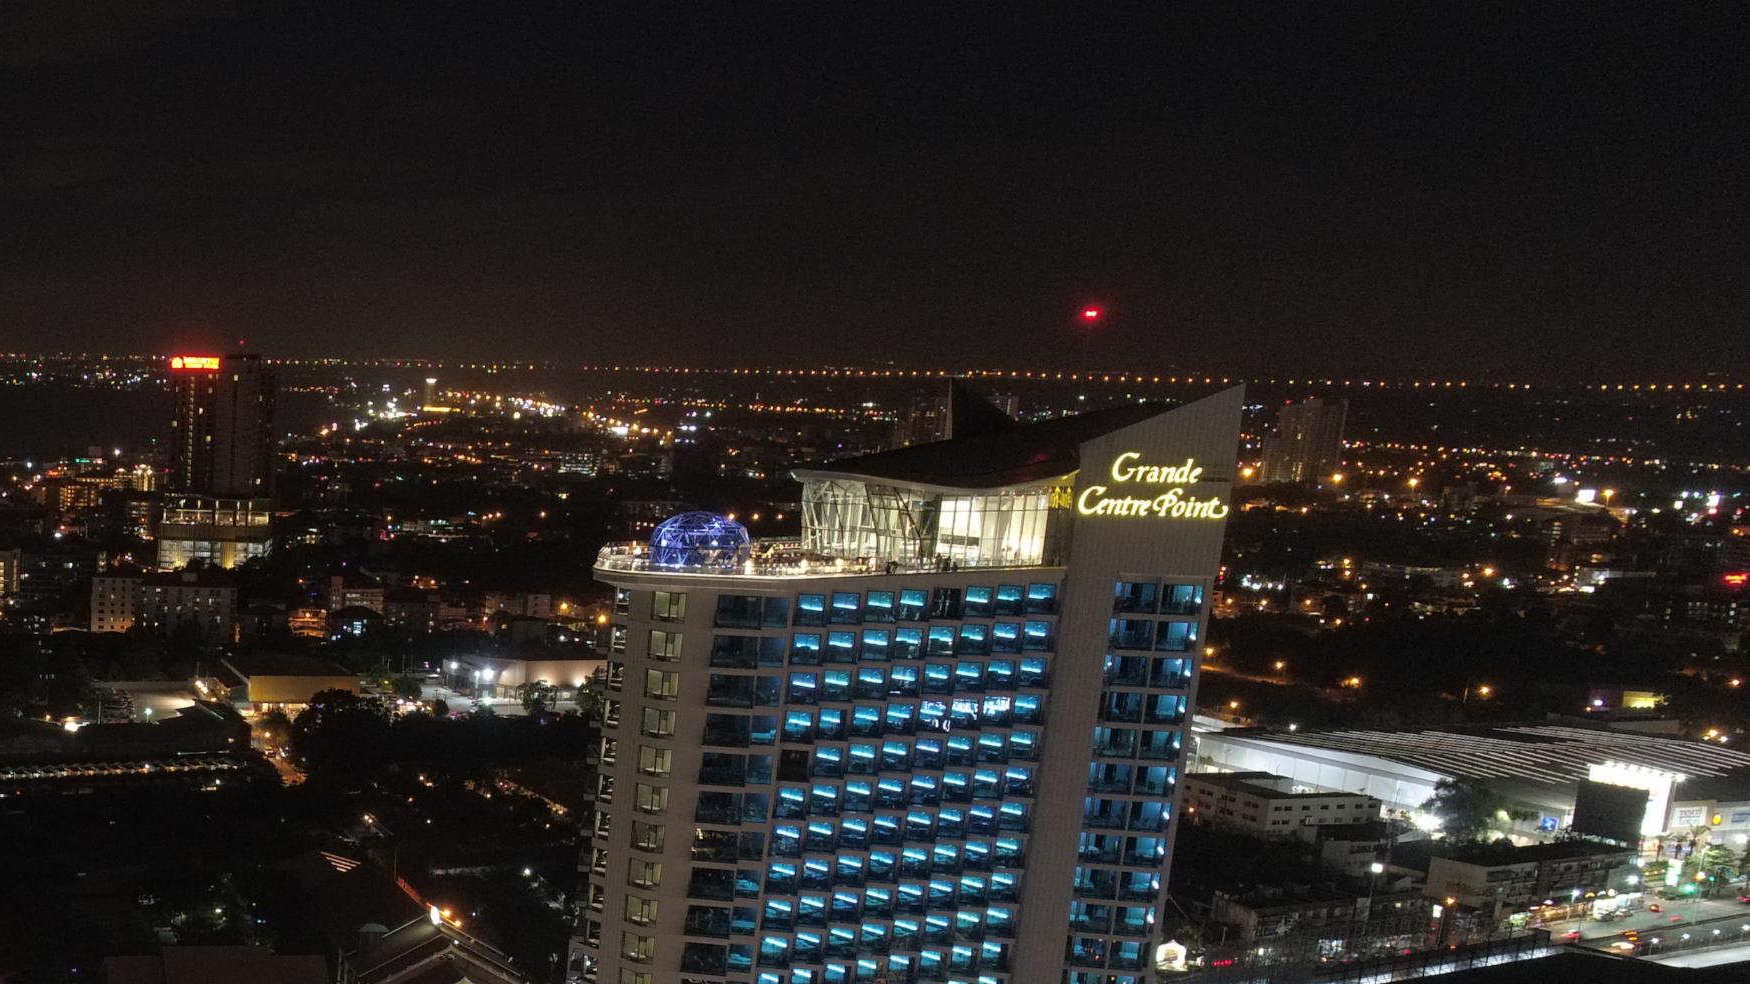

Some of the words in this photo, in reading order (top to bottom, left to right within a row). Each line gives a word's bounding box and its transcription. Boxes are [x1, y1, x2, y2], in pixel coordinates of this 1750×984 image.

[1112, 451, 1203, 484] Grande
[1077, 485, 1152, 516] Centre
[1153, 488, 1229, 519] Point
